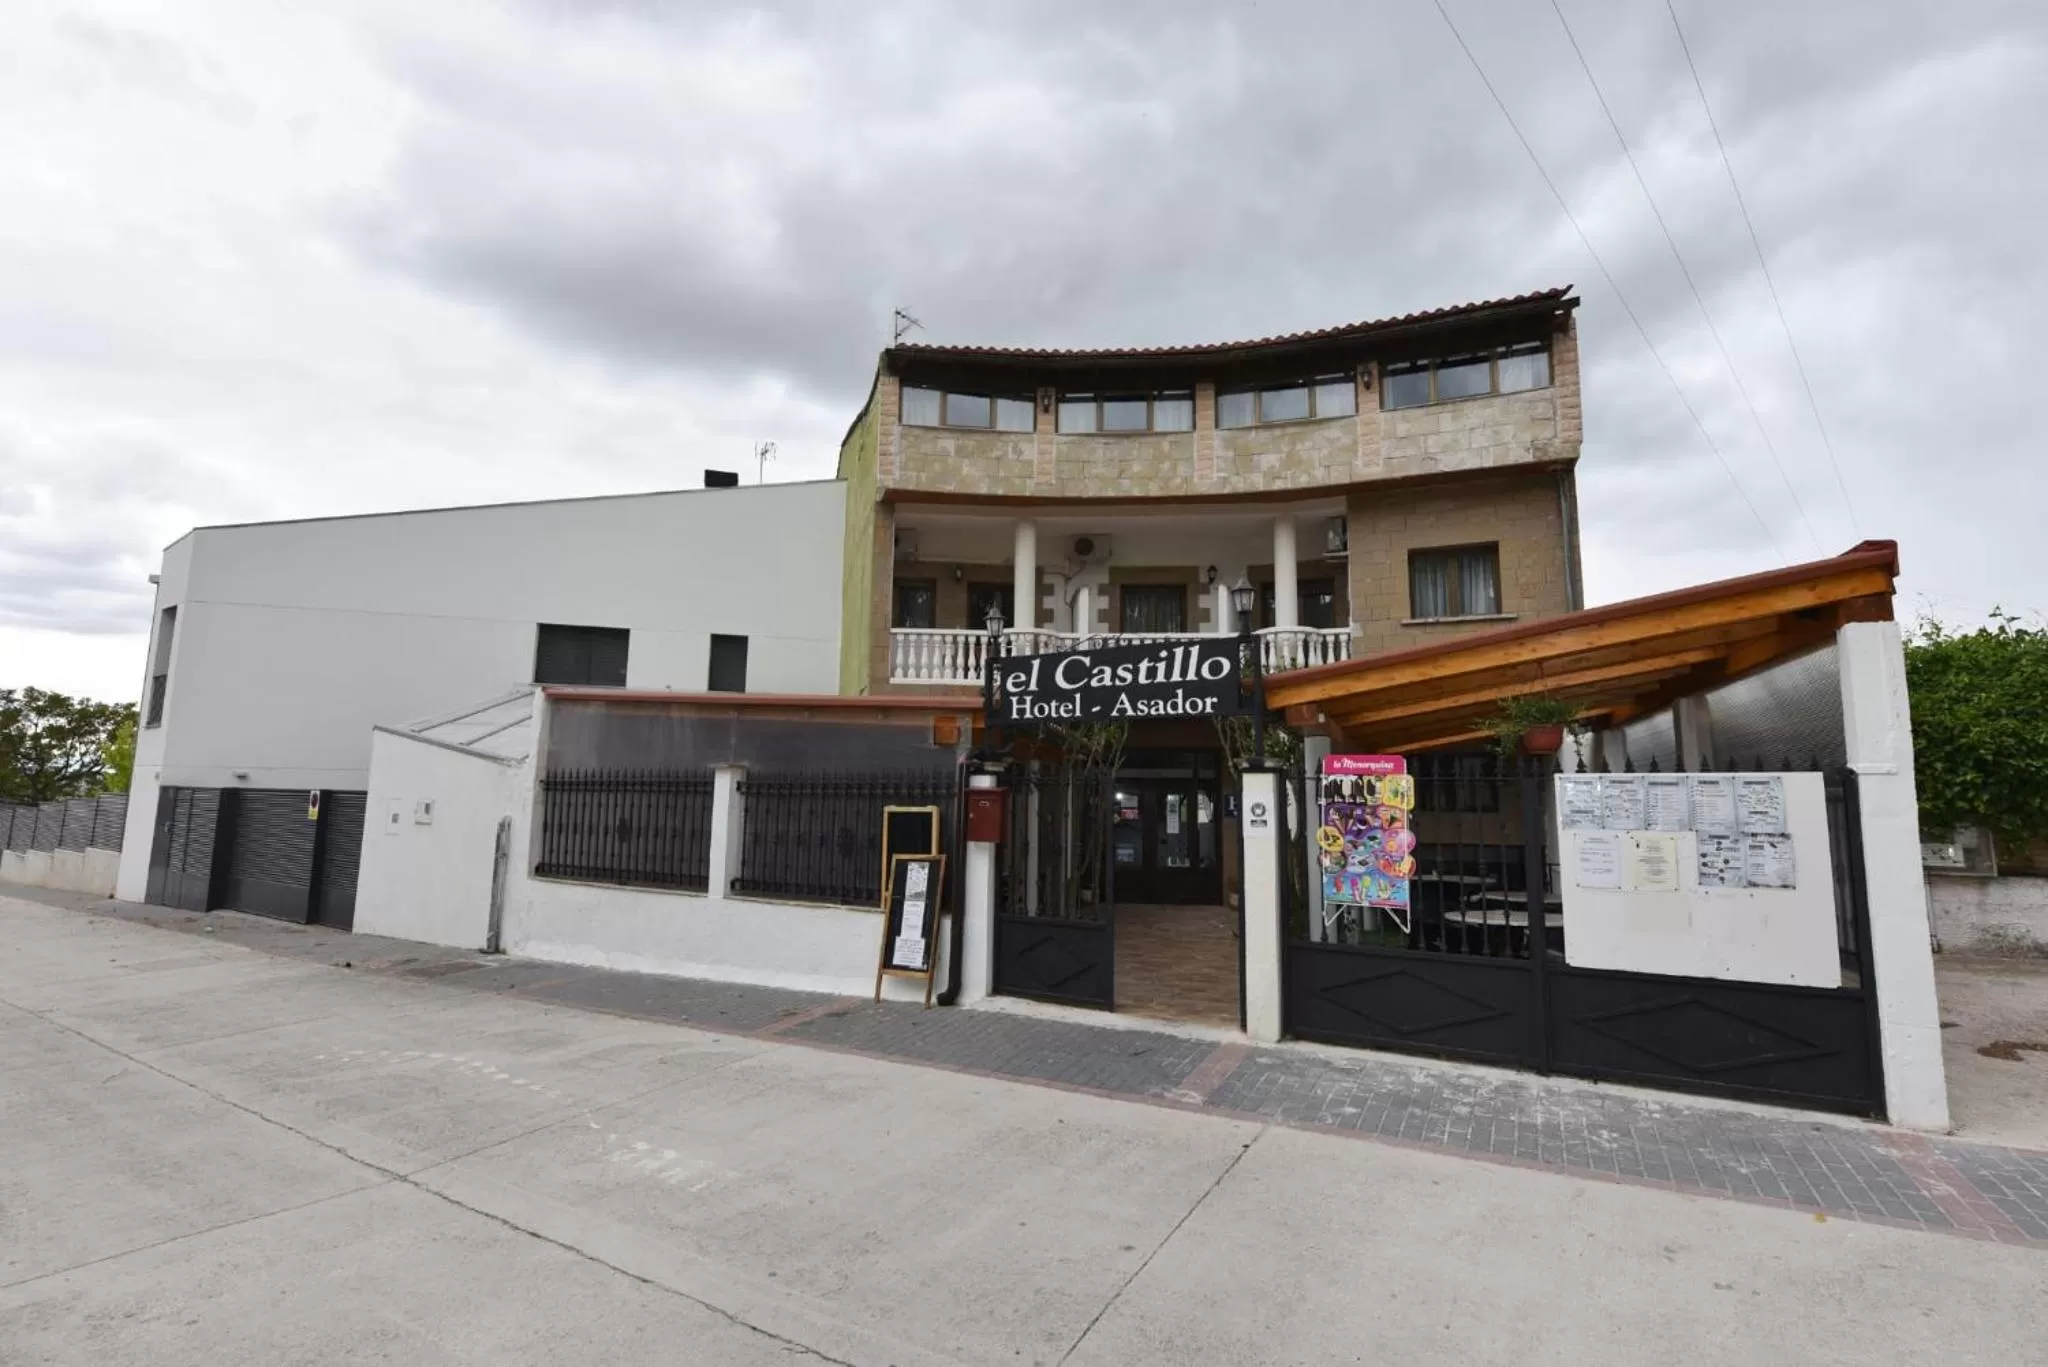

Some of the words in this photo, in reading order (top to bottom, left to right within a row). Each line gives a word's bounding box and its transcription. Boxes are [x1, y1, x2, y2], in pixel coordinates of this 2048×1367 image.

[1005, 659, 1040, 693] el
[1054, 644, 1232, 690] Castillo
[1009, 695, 1082, 719] Hotel
[1110, 688, 1219, 717] Asador
